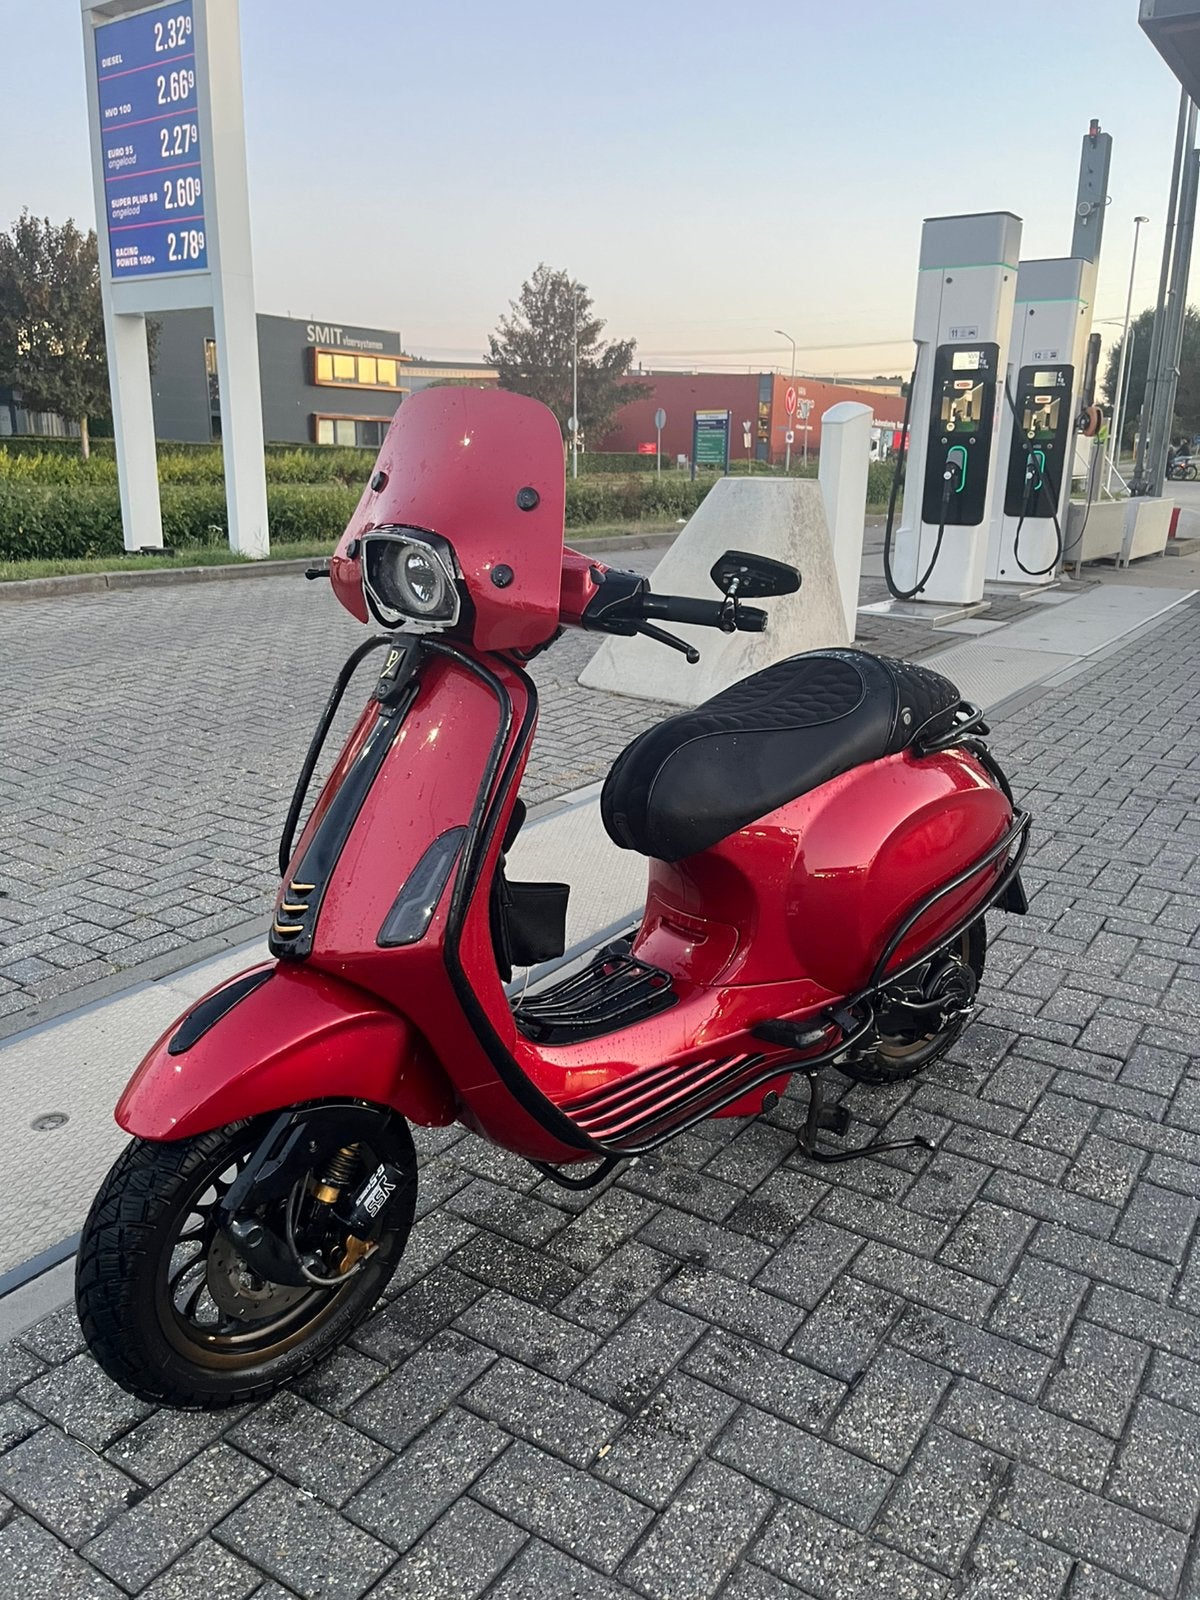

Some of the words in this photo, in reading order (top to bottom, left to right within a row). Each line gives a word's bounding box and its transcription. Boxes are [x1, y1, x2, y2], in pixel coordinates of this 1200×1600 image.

[102, 54, 123, 68] DIESEL
[105, 107, 118, 118] HVO
[119, 103, 132, 115] 100
[107, 147, 124, 159] EURO
[125, 145, 134, 156] 95
[108, 154, 137, 170] ongelood
[111, 197, 132, 208] SUPER
[132, 193, 148, 205] PLUS
[149, 192, 158, 203] 98
[112, 205, 140, 220] ongelood
[115, 246, 139, 258] RACING
[116, 257, 138, 268] POWER
[139, 255, 155, 266] 100+
[306, 324, 343, 345] SMIT
[363, 1174, 397, 1218] YSS
